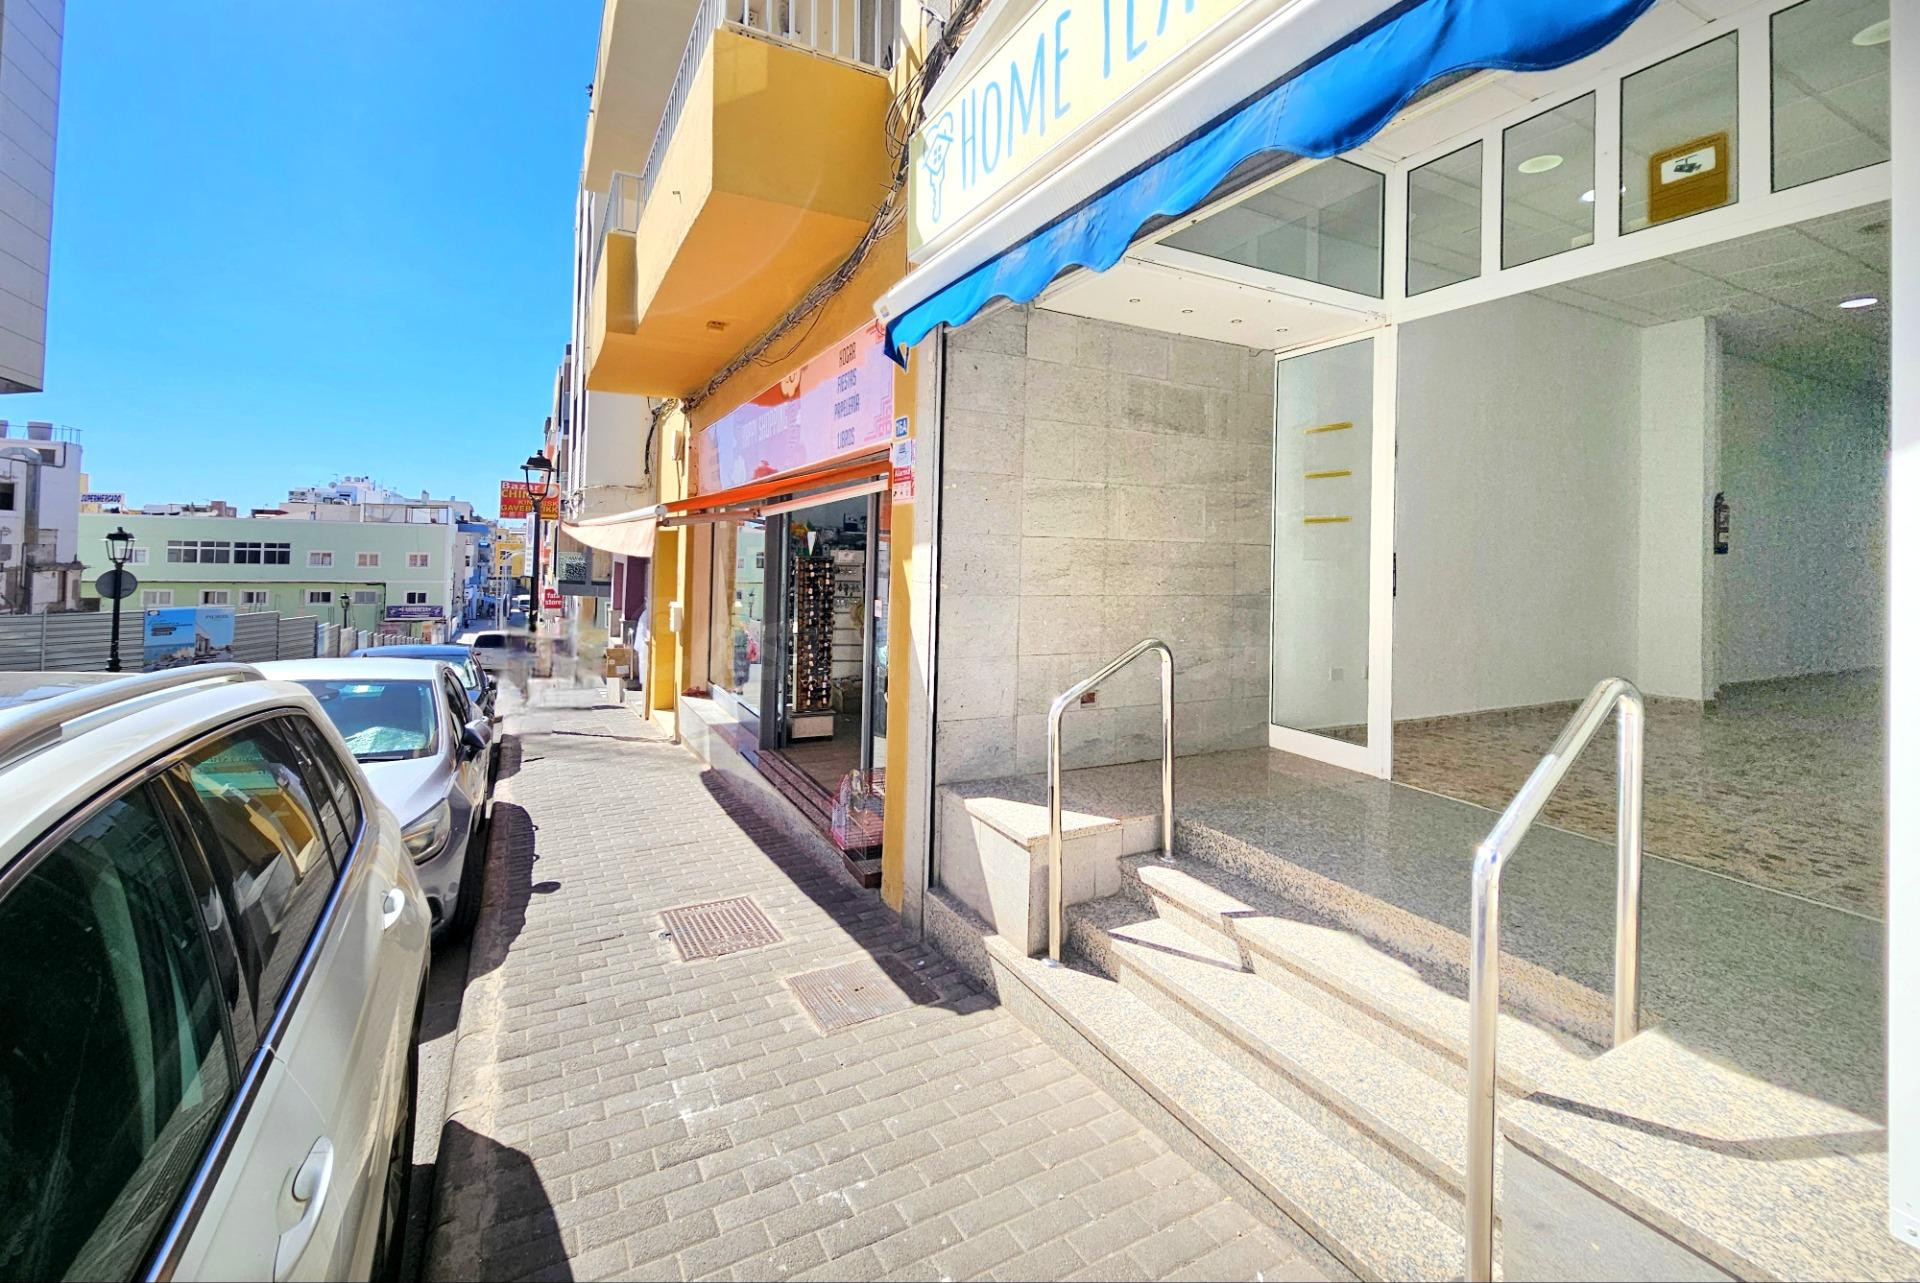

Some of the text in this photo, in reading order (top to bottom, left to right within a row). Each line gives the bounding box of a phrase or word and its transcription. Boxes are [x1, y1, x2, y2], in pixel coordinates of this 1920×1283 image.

[961, 9, 1072, 191] HOME
[839, 341, 857, 369] HOGAR
[837, 368, 857, 393] FIESTAS
[837, 427, 856, 449] LIBROS
[502, 481, 541, 491] Bazar
[81, 494, 121, 503] SUPERMERCADO
